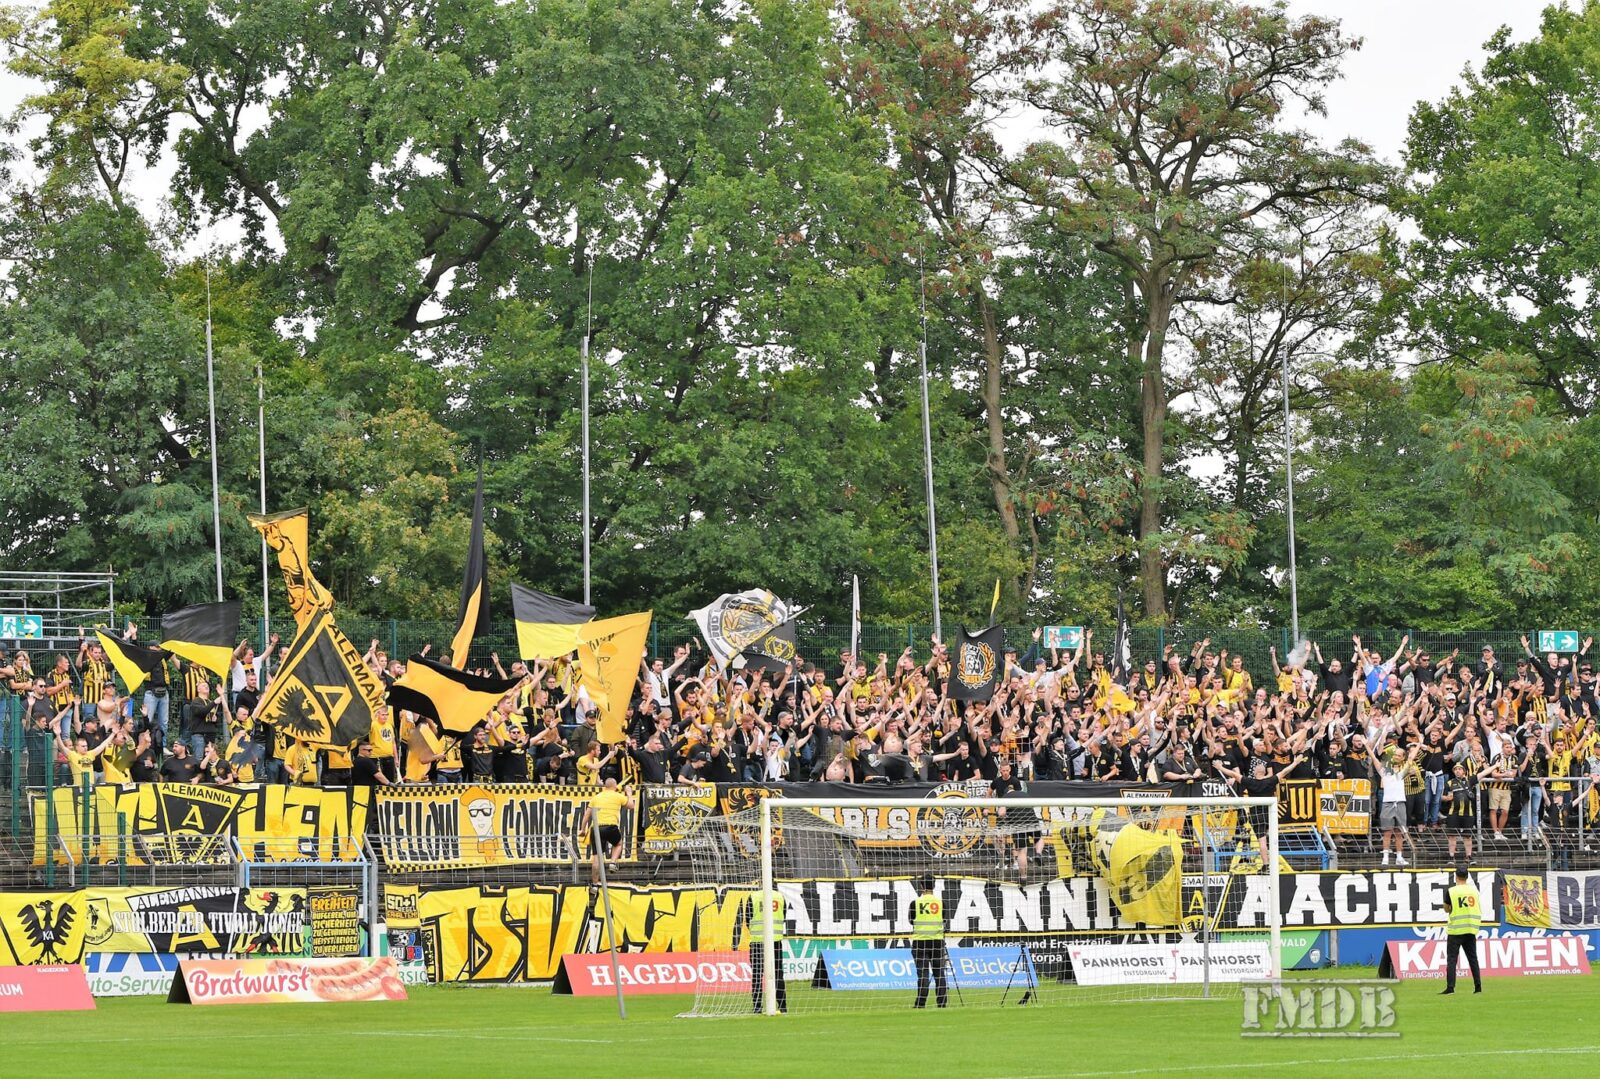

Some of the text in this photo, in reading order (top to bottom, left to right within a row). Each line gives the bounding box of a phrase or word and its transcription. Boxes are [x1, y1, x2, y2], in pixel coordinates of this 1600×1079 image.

[162, 783, 233, 805] ALEMANNIA
[675, 787, 712, 798] STADT
[1202, 783, 1230, 797] SZENE
[181, 805, 204, 829] A
[379, 799, 635, 861] YELLOW CONNECN
[649, 840, 669, 849] UND
[136, 887, 238, 911] ALEMANNIA
[311, 897, 356, 910] FREIHEIT
[777, 876, 1164, 934] ALEMANNI
[1188, 890, 1205, 912] A
[1458, 896, 1476, 909] K9
[919, 902, 940, 915] K9
[112, 911, 204, 934] STOLBERGER
[208, 911, 257, 934] TIVOLI
[261, 912, 305, 934] JONGE
[43, 931, 54, 940] KA
[1082, 956, 1165, 968] PANNHORST
[1401, 969, 1444, 979] TransCargo
[1523, 967, 1582, 976] www.kahmen.de
[189, 966, 310, 997] Bratwurst
